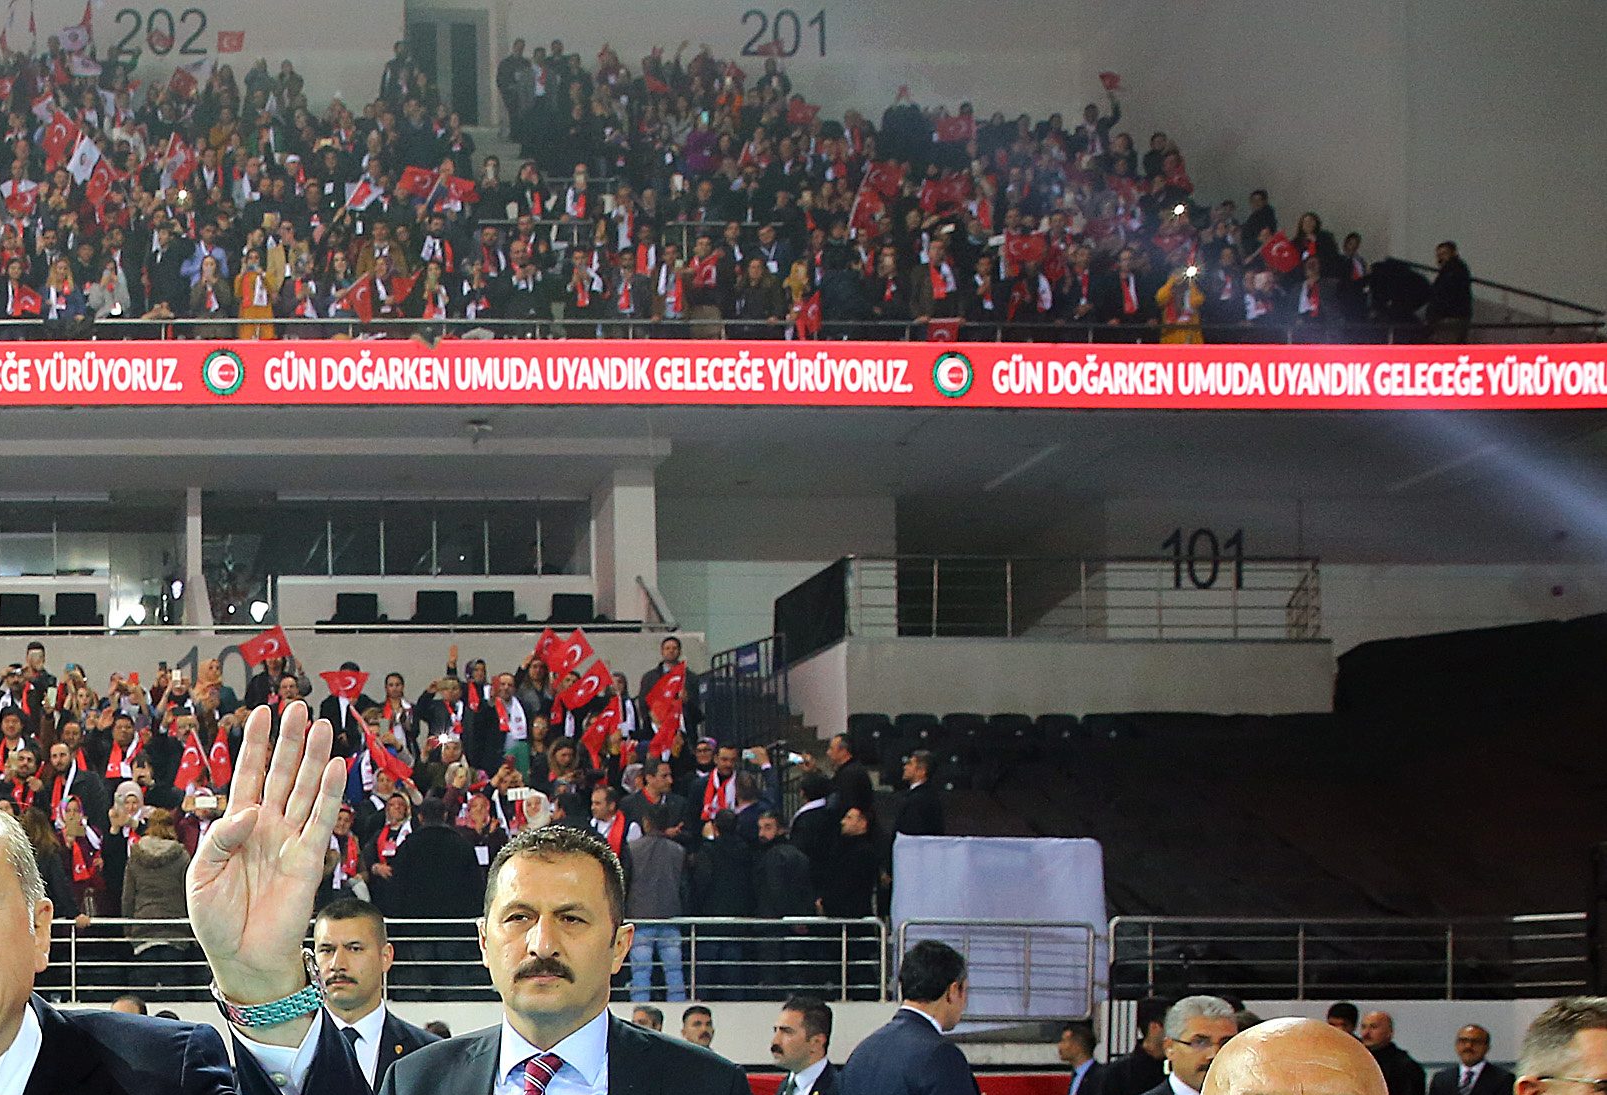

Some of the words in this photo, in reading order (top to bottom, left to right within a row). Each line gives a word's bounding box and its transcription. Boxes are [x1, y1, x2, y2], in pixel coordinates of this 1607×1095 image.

[115, 8, 207, 55] 202
[741, 9, 825, 57] 201
[34, 352, 183, 391] YÜRÜYORUZ.
[264, 351, 317, 390] GÜN
[321, 350, 450, 390] DOĞARKEN
[454, 357, 544, 391] UMUDA
[546, 357, 651, 390] UYANDIK
[653, 351, 765, 391] GELECEĞE
[766, 352, 914, 392] YÜRÜYORUZ.
[992, 354, 1044, 393] GÜN
[1047, 354, 1174, 394] DOĞARKEN
[1177, 362, 1266, 396] UMUDA
[1267, 362, 1372, 396] UYANDIK
[1373, 356, 1485, 395] GELECEĞE
[1162, 528, 1243, 589] 101
